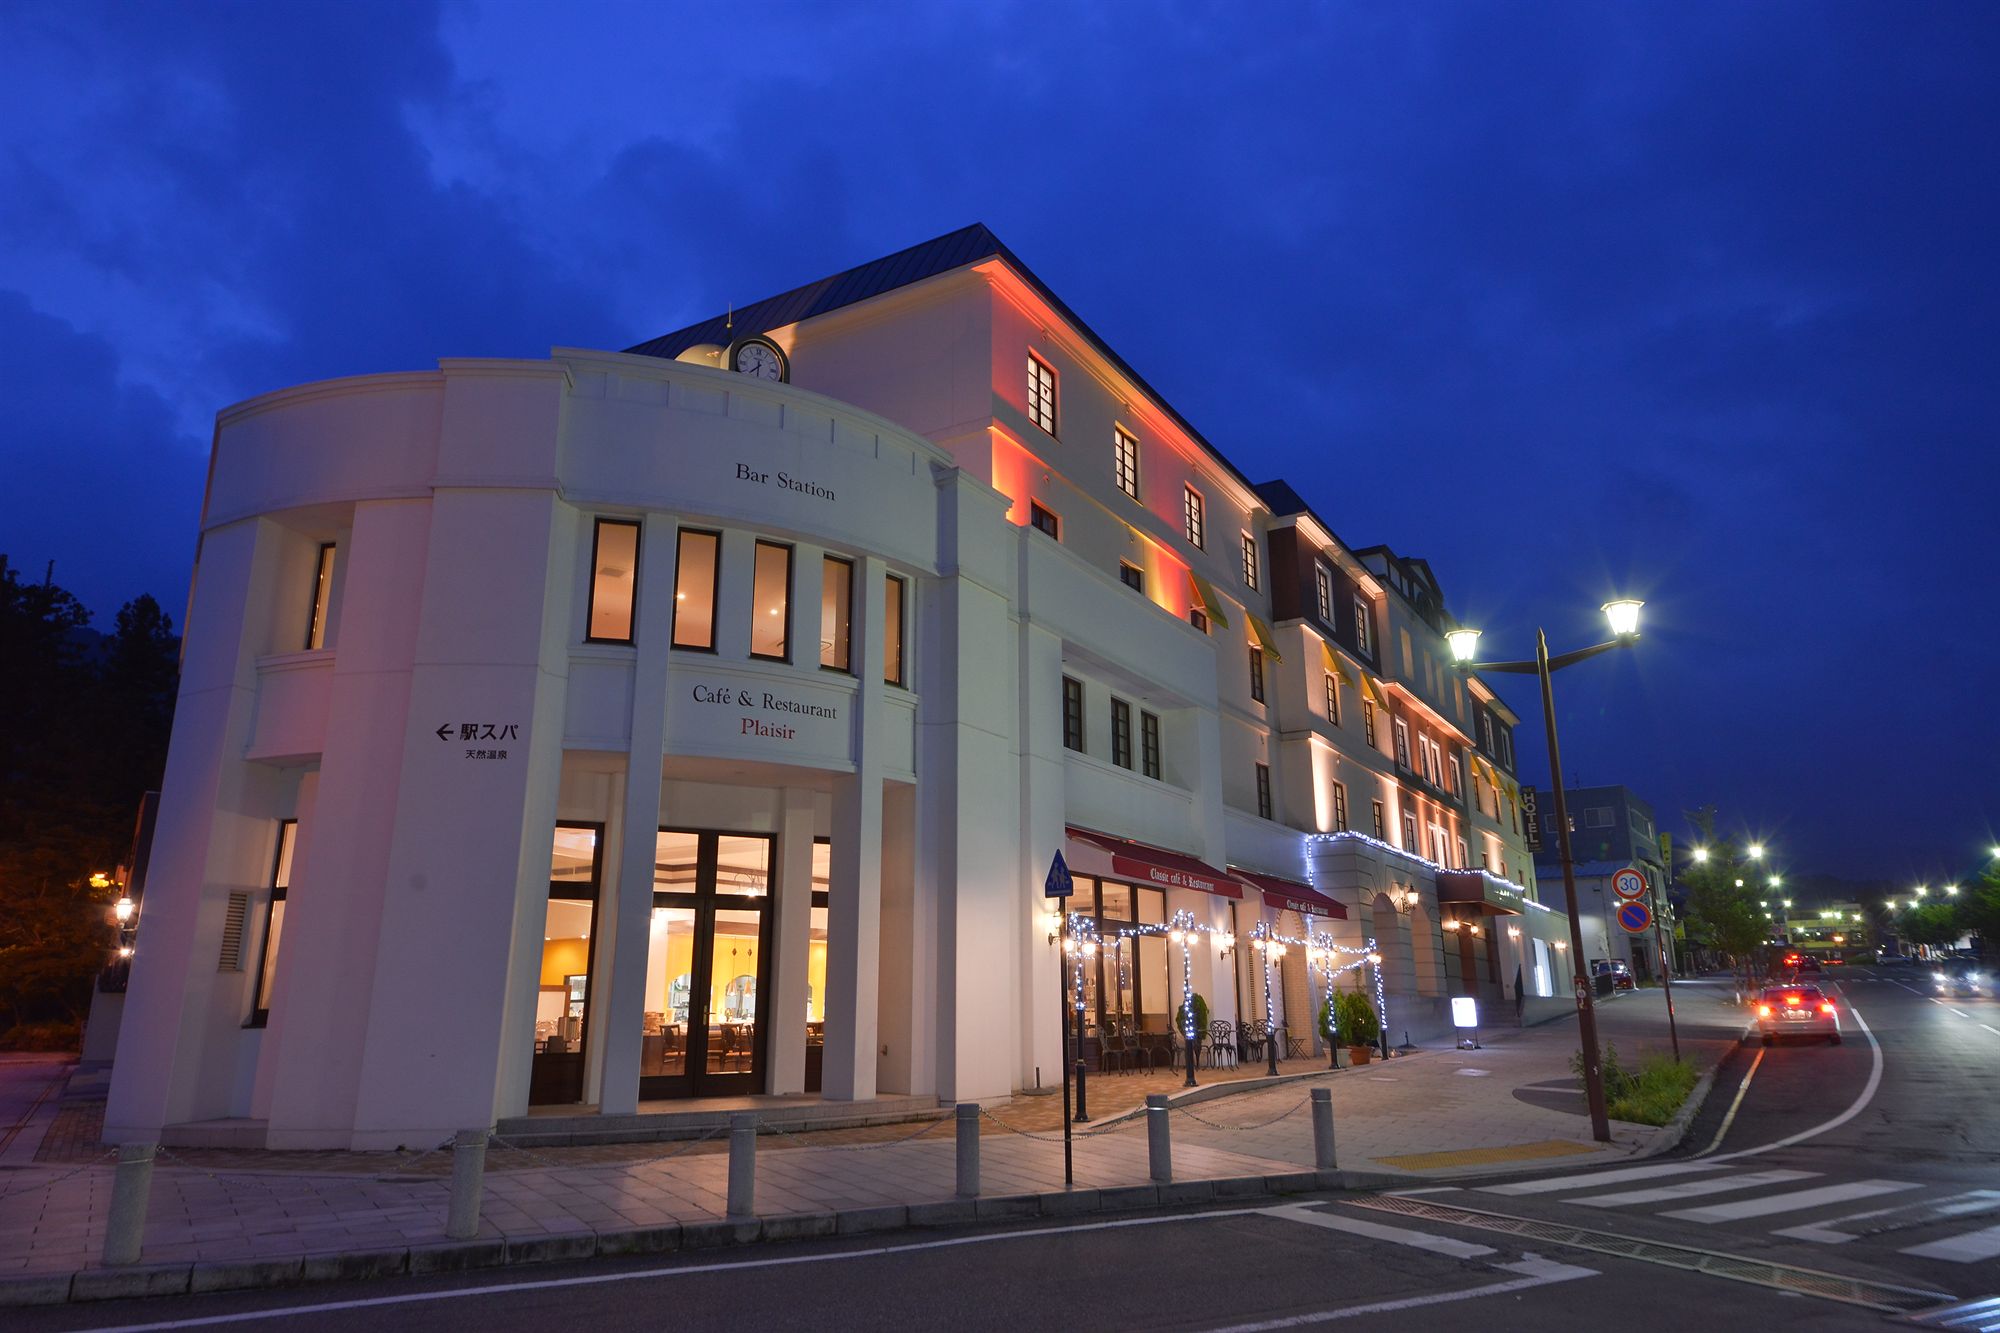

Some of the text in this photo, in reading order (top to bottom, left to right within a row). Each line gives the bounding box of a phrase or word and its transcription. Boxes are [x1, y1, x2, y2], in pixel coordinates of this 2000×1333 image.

[736, 462, 836, 501] Bar Station
[692, 684, 838, 720] Café & Restaurant
[460, 723, 519, 741] 駅スパ
[741, 717, 796, 740] Plaisir
[465, 749, 508, 760] 天然温泉
[1523, 792, 1539, 843] HOTEL
[1620, 877, 1639, 891] 30
